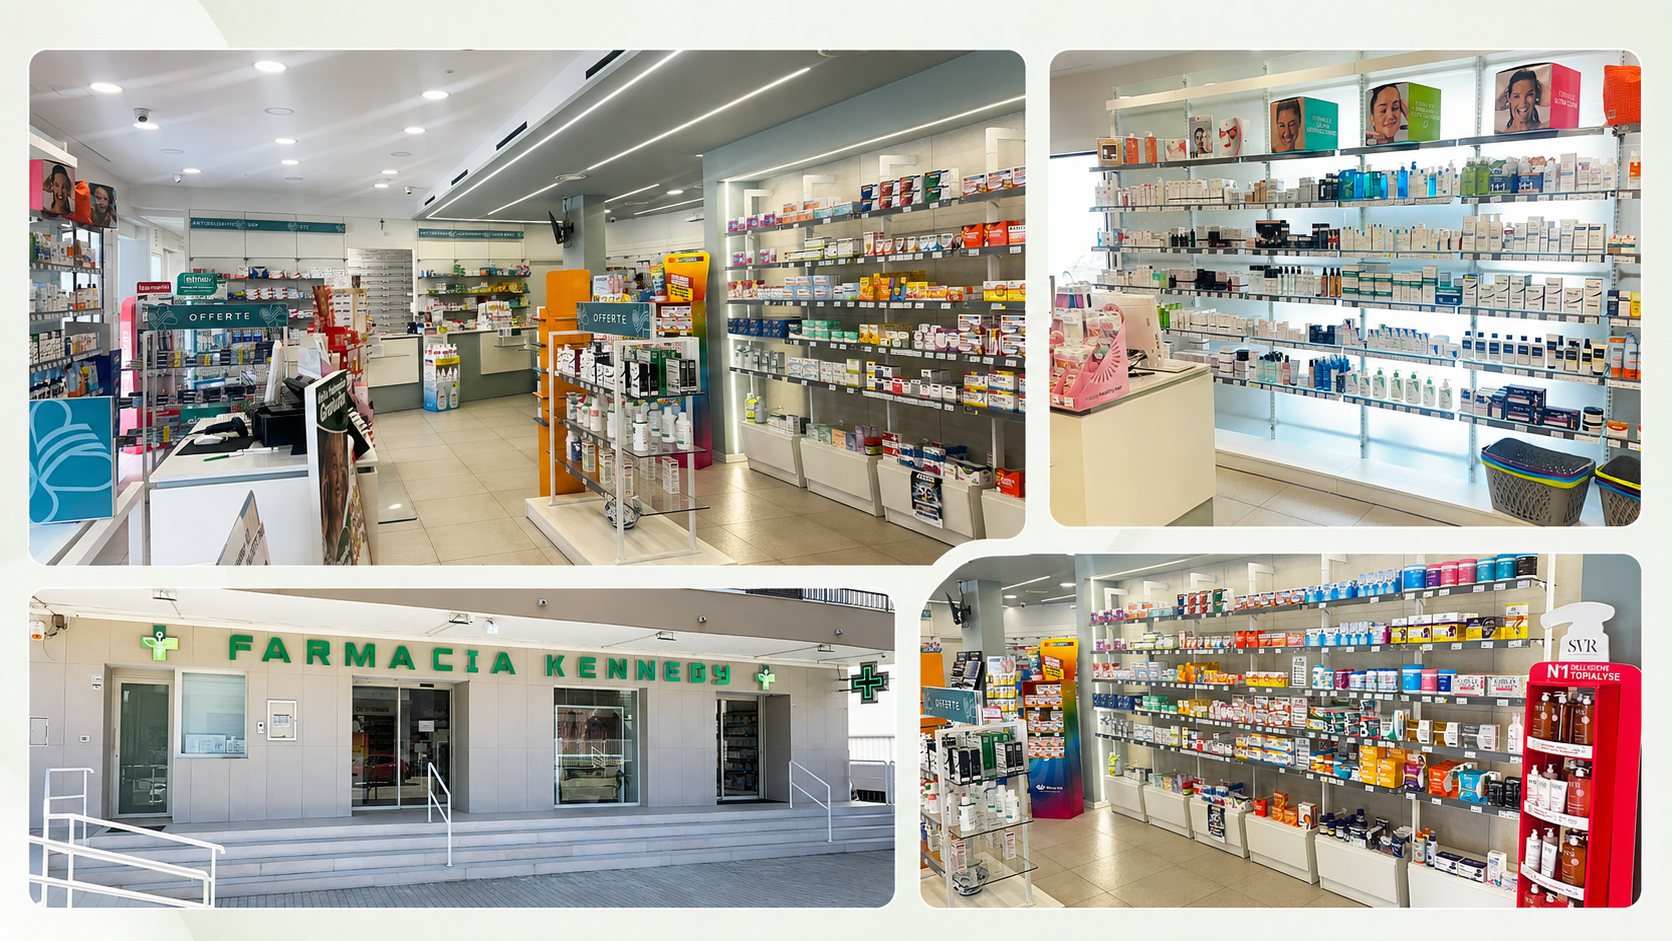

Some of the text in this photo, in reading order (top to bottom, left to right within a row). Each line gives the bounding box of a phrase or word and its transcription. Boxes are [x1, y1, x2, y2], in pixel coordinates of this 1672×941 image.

[189, 312, 250, 322] OFFERTE
[593, 313, 627, 325] OFFERTE
[1567, 638, 1598, 653] SVR
[229, 633, 731, 685] FARMACIA KENNEDY
[1570, 671, 1621, 681] TOPIALYSE
[935, 698, 960, 711] OFFERTE
